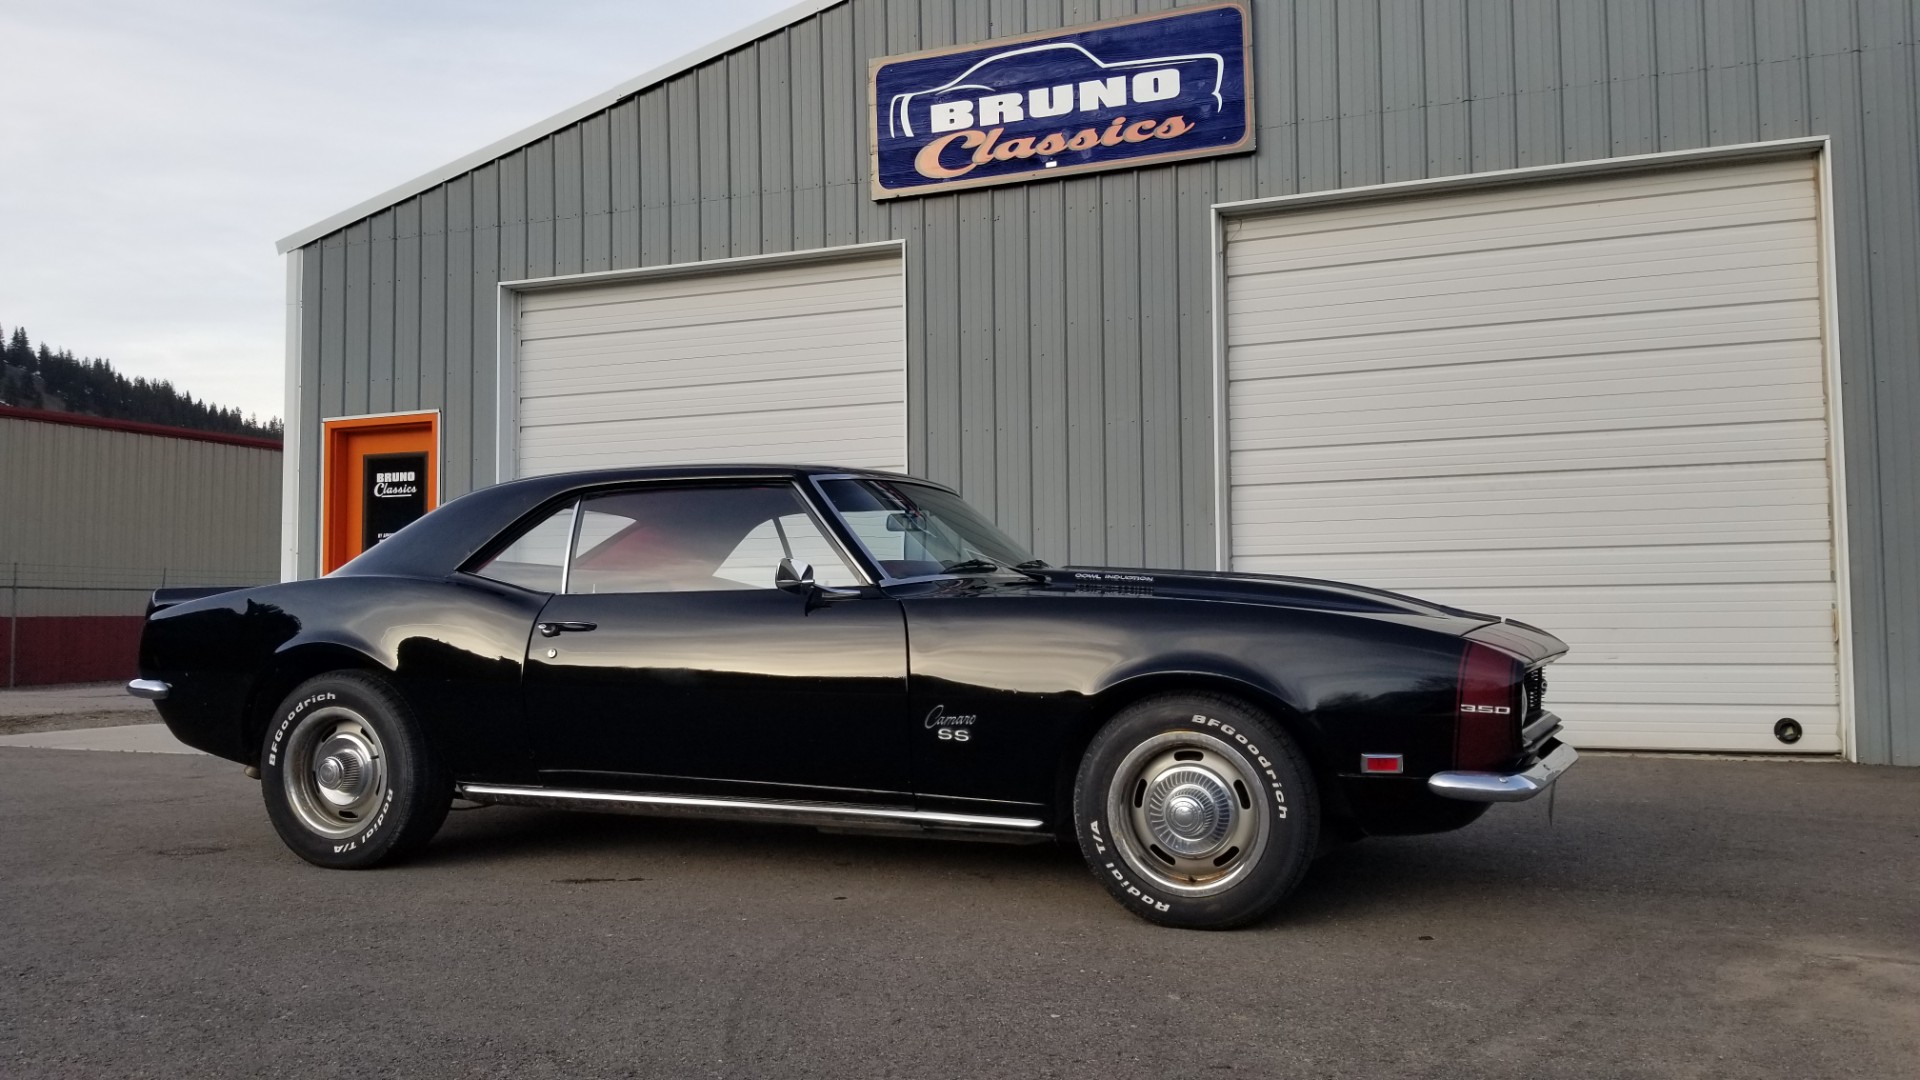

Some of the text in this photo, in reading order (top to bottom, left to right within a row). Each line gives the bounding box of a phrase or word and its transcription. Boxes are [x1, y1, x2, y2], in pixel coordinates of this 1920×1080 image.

[930, 68, 1180, 133] BRUNO
[914, 114, 1195, 179] Classics
[373, 482, 417, 497] Classics
[376, 471, 416, 483] BRUNO
[268, 692, 336, 766] BFGoodrich
[924, 704, 976, 729] Camaro
[938, 728, 969, 741] SS
[1460, 704, 1510, 715] 350
[1191, 714, 1288, 819] BFGoodrich
[334, 788, 393, 853] Radial T/A
[1090, 820, 1171, 912] Radial T/A
